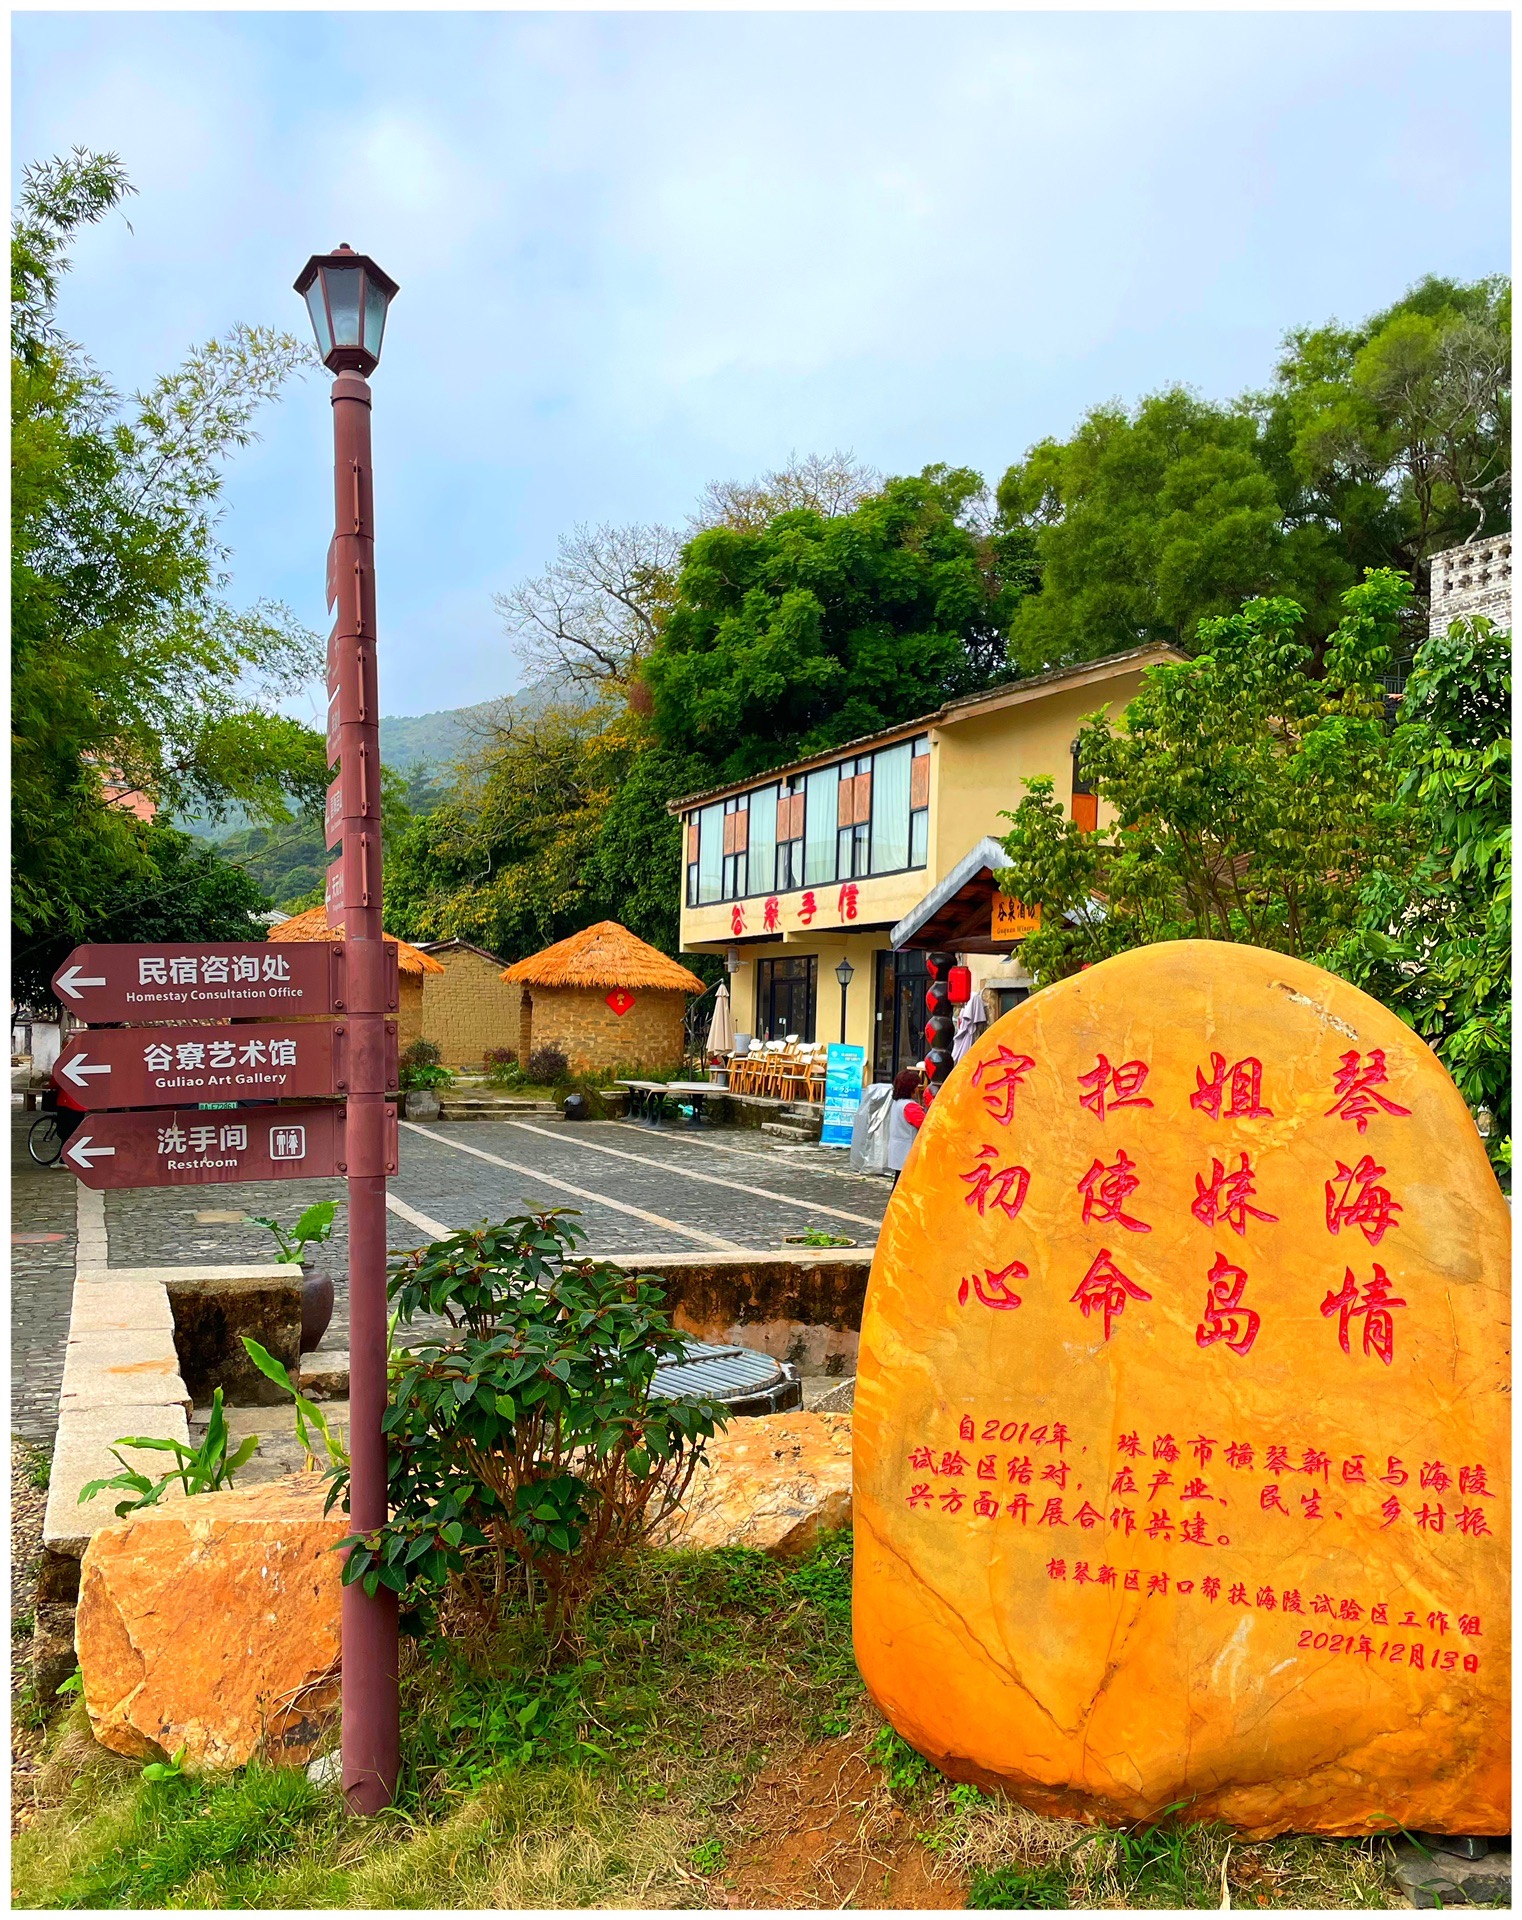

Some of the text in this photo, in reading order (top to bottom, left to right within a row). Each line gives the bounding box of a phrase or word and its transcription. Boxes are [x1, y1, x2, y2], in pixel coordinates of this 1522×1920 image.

[138, 954, 291, 986] 民宿咨询处
[126, 987, 303, 1003] Homestay Consultation Office
[143, 1039, 297, 1073] 谷寮艺术馆
[155, 1072, 287, 1088] Guliao Art Gallery
[157, 1125, 247, 1154] 洗手间
[167, 1157, 238, 1170] Restroom
[958, 1044, 1037, 1311] 守初心
[1069, 1052, 1155, 1342] 担使命
[1189, 1051, 1280, 1358] 姐妹岛
[1320, 1048, 1413, 1367] 琴海情
[1046, 1557, 1483, 1638] 横琴新区对口帮扶海陵试验区工作组
[1297, 1629, 1480, 1675] 2021年12月13日
